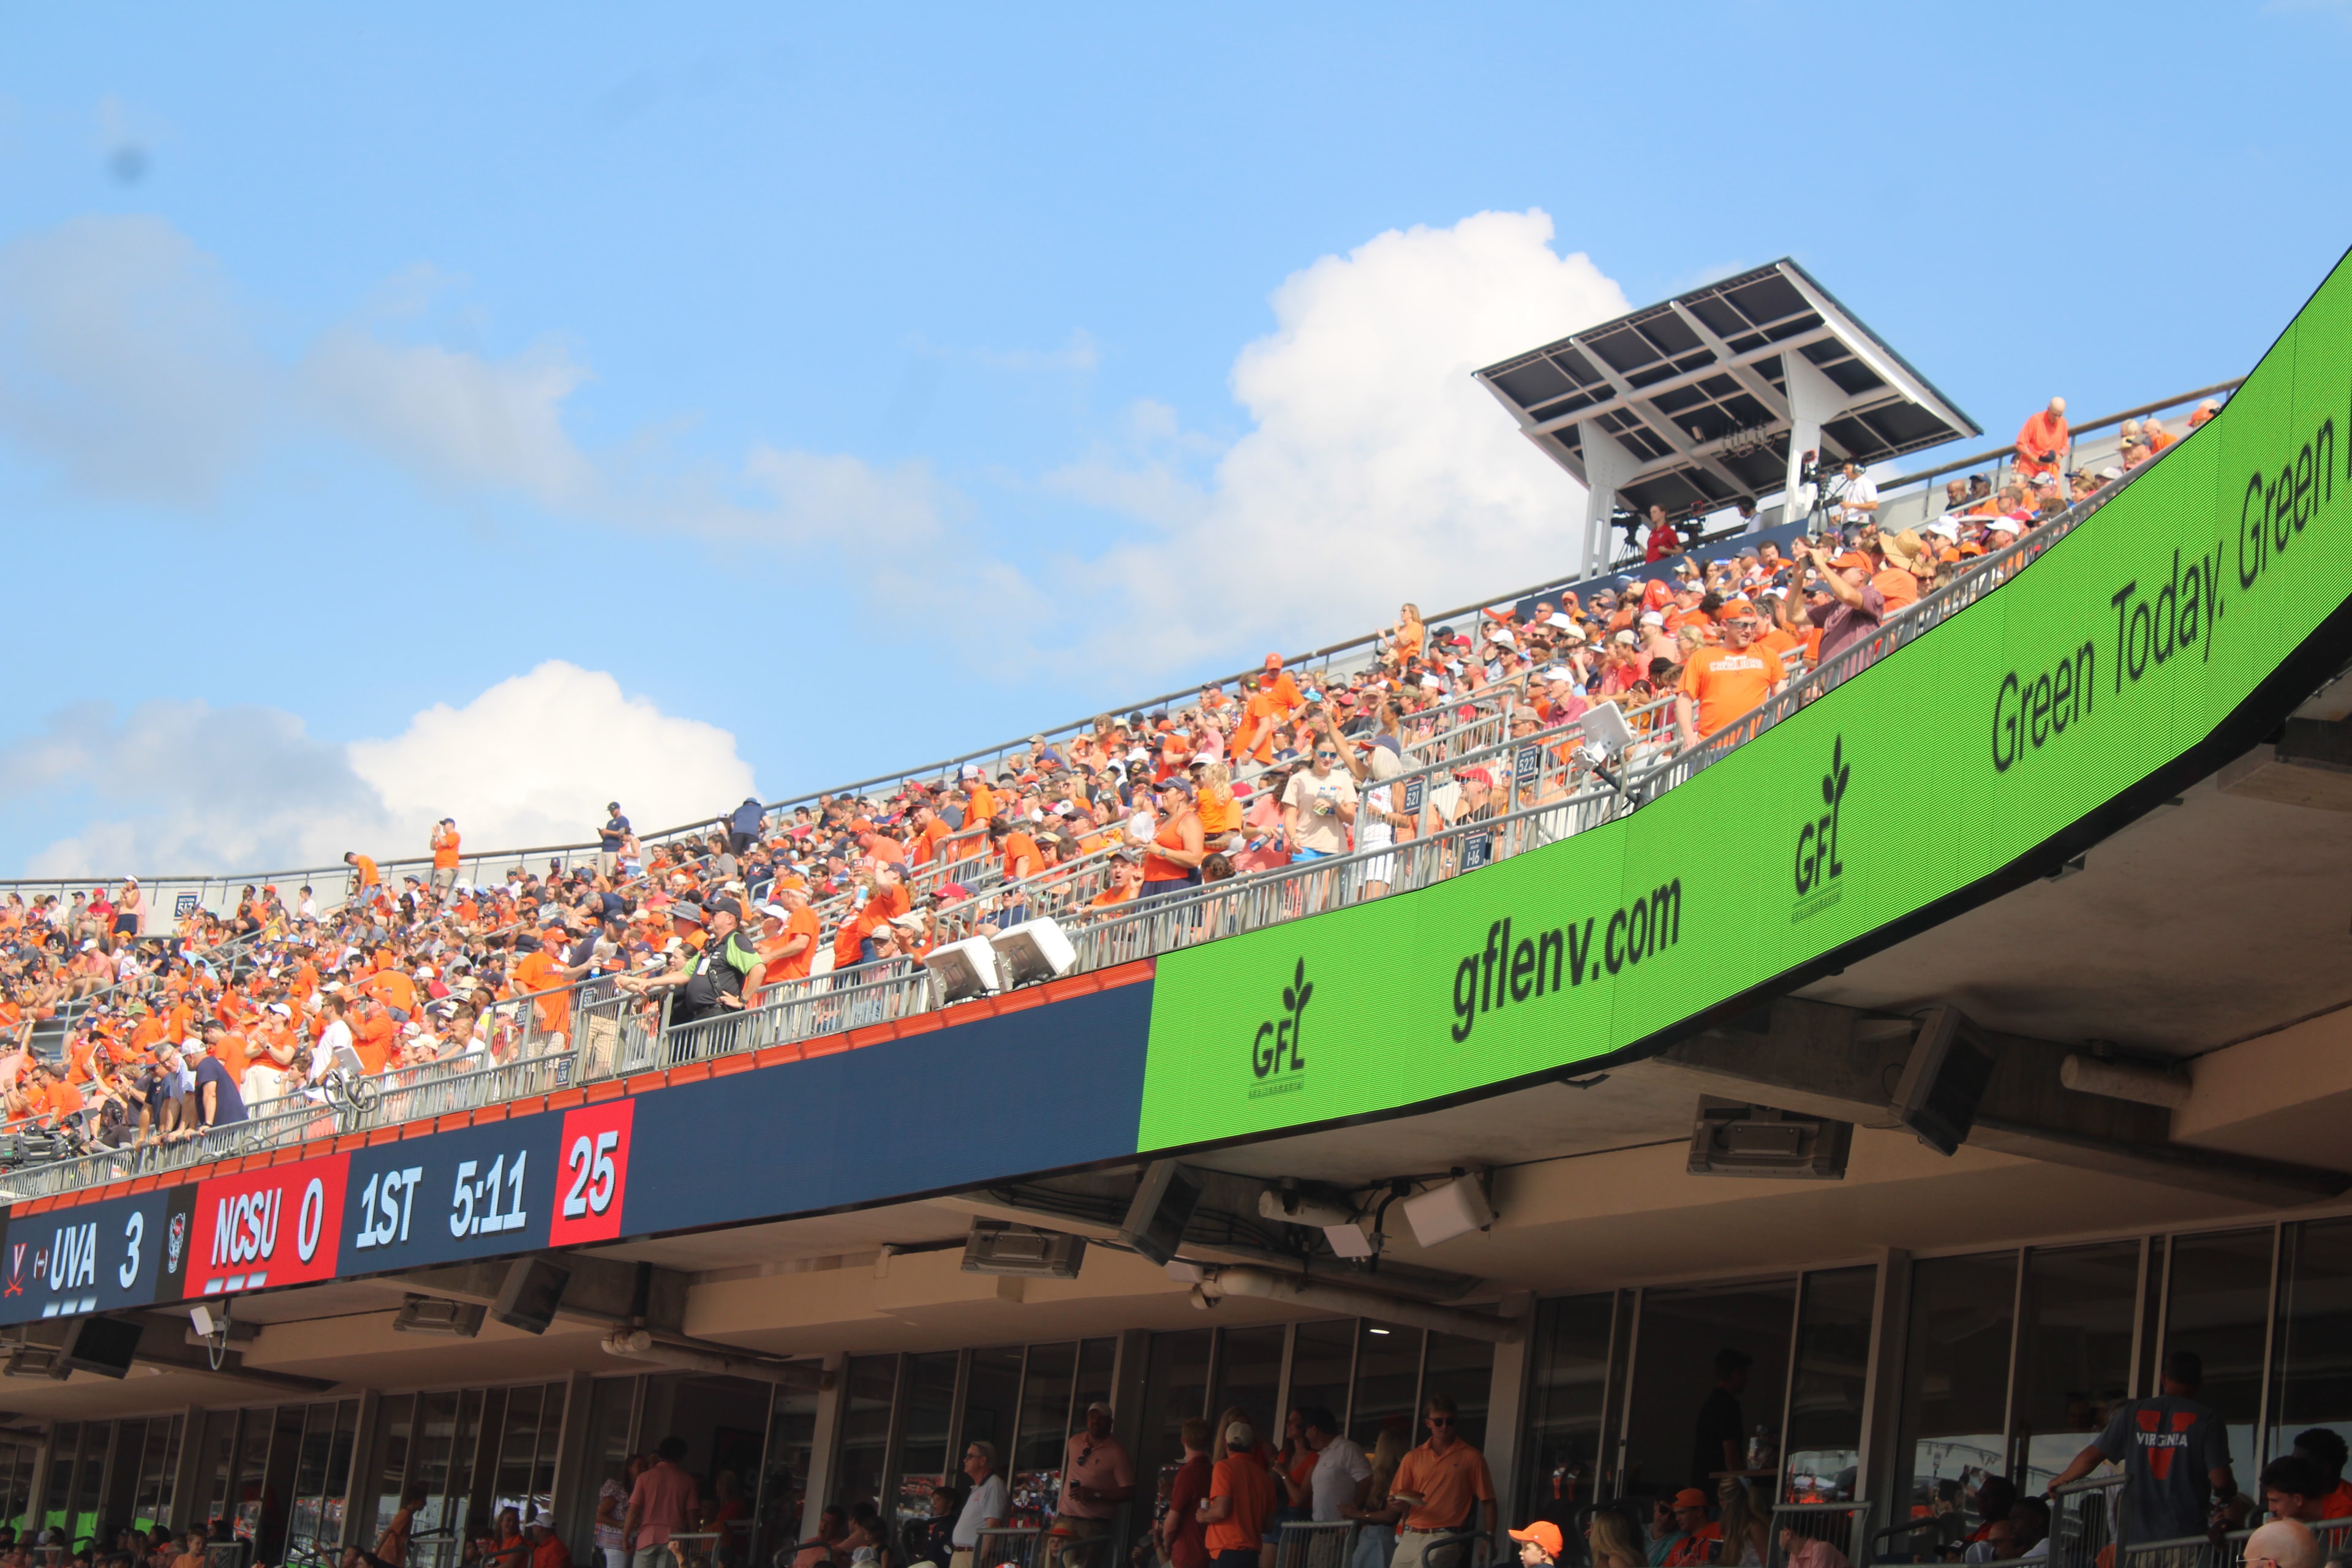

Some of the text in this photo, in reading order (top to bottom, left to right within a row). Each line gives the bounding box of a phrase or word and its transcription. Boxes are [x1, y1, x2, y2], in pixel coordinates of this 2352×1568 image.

[1992, 639, 2095, 774] Green
[2111, 539, 2226, 694] Today.
[2239, 417, 2334, 590] Green
[1709, 658, 1763, 671] CAVALIERS
[1519, 756, 1534, 774] 522
[1406, 790, 1419, 807] 521
[1467, 849, 1480, 866] 1-16
[1451, 876, 1682, 1044] gflenv.com
[516, 1011, 526, 1023] 520
[563, 1130, 619, 1217] 25
[211, 1177, 325, 1267] NCSU 0
[356, 1149, 528, 1249] 1ST 5:11
[50, 1222, 97, 1291] UVA
[119, 1210, 144, 1289] 3
[2135, 1432, 2188, 1447] VIRGINIA
